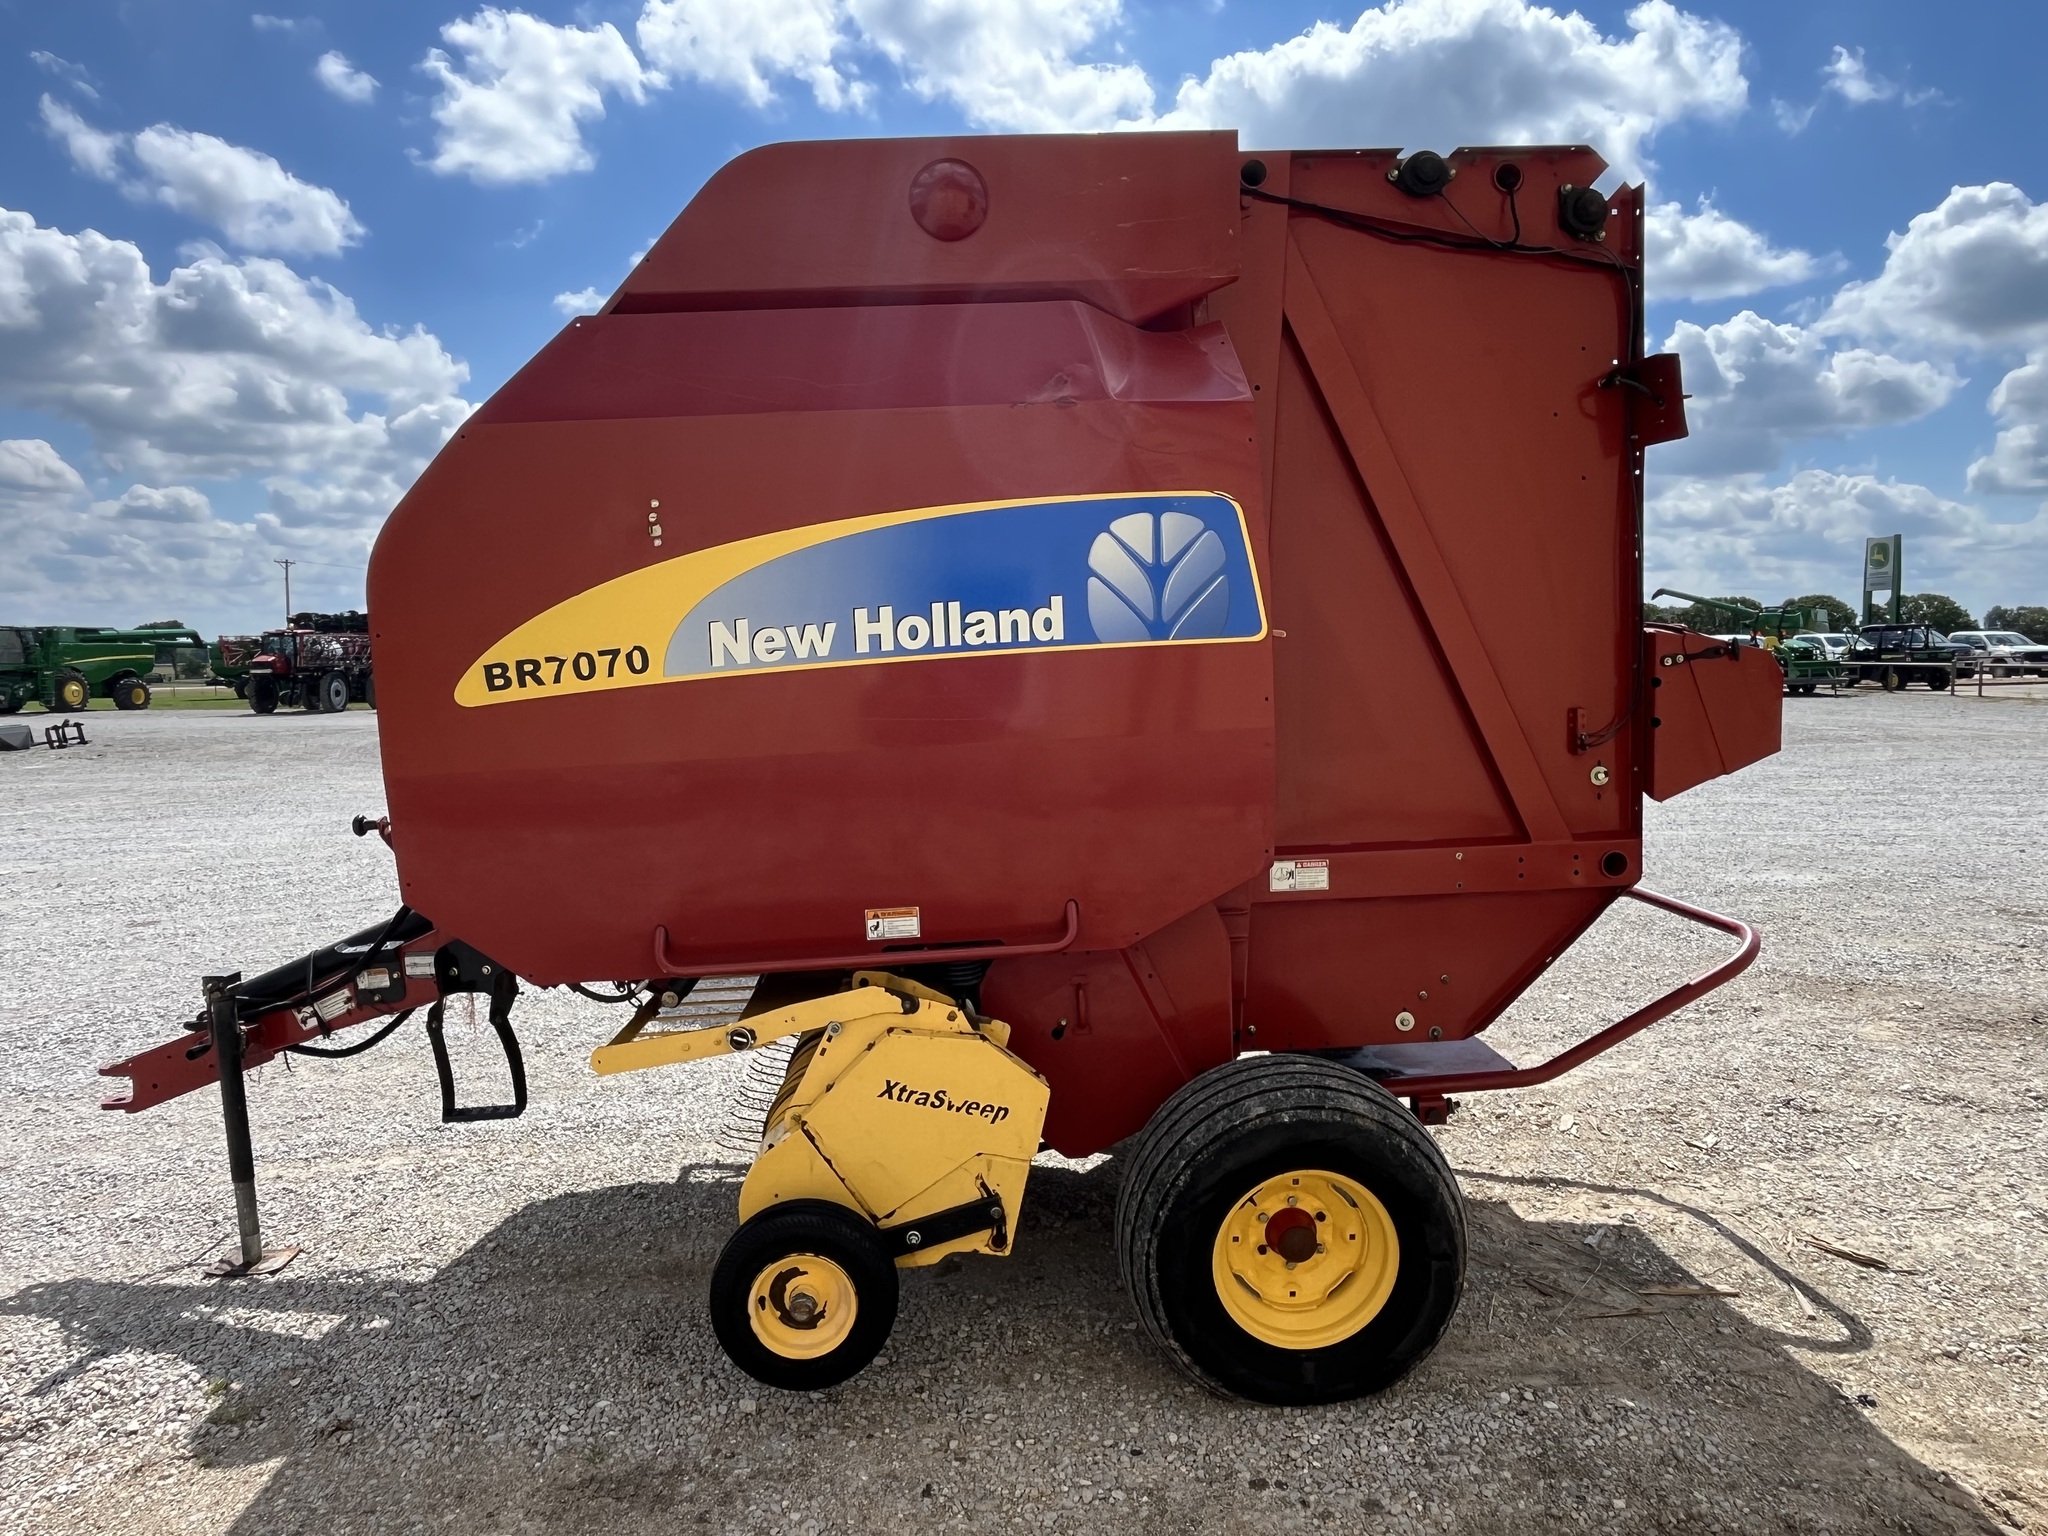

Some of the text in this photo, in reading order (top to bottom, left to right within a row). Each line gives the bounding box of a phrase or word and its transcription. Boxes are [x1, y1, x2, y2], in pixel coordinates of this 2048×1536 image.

[708, 595, 1064, 667] New Holland
[483, 645, 649, 692] BR7070
[877, 1079, 1009, 1124] XtraSweep
